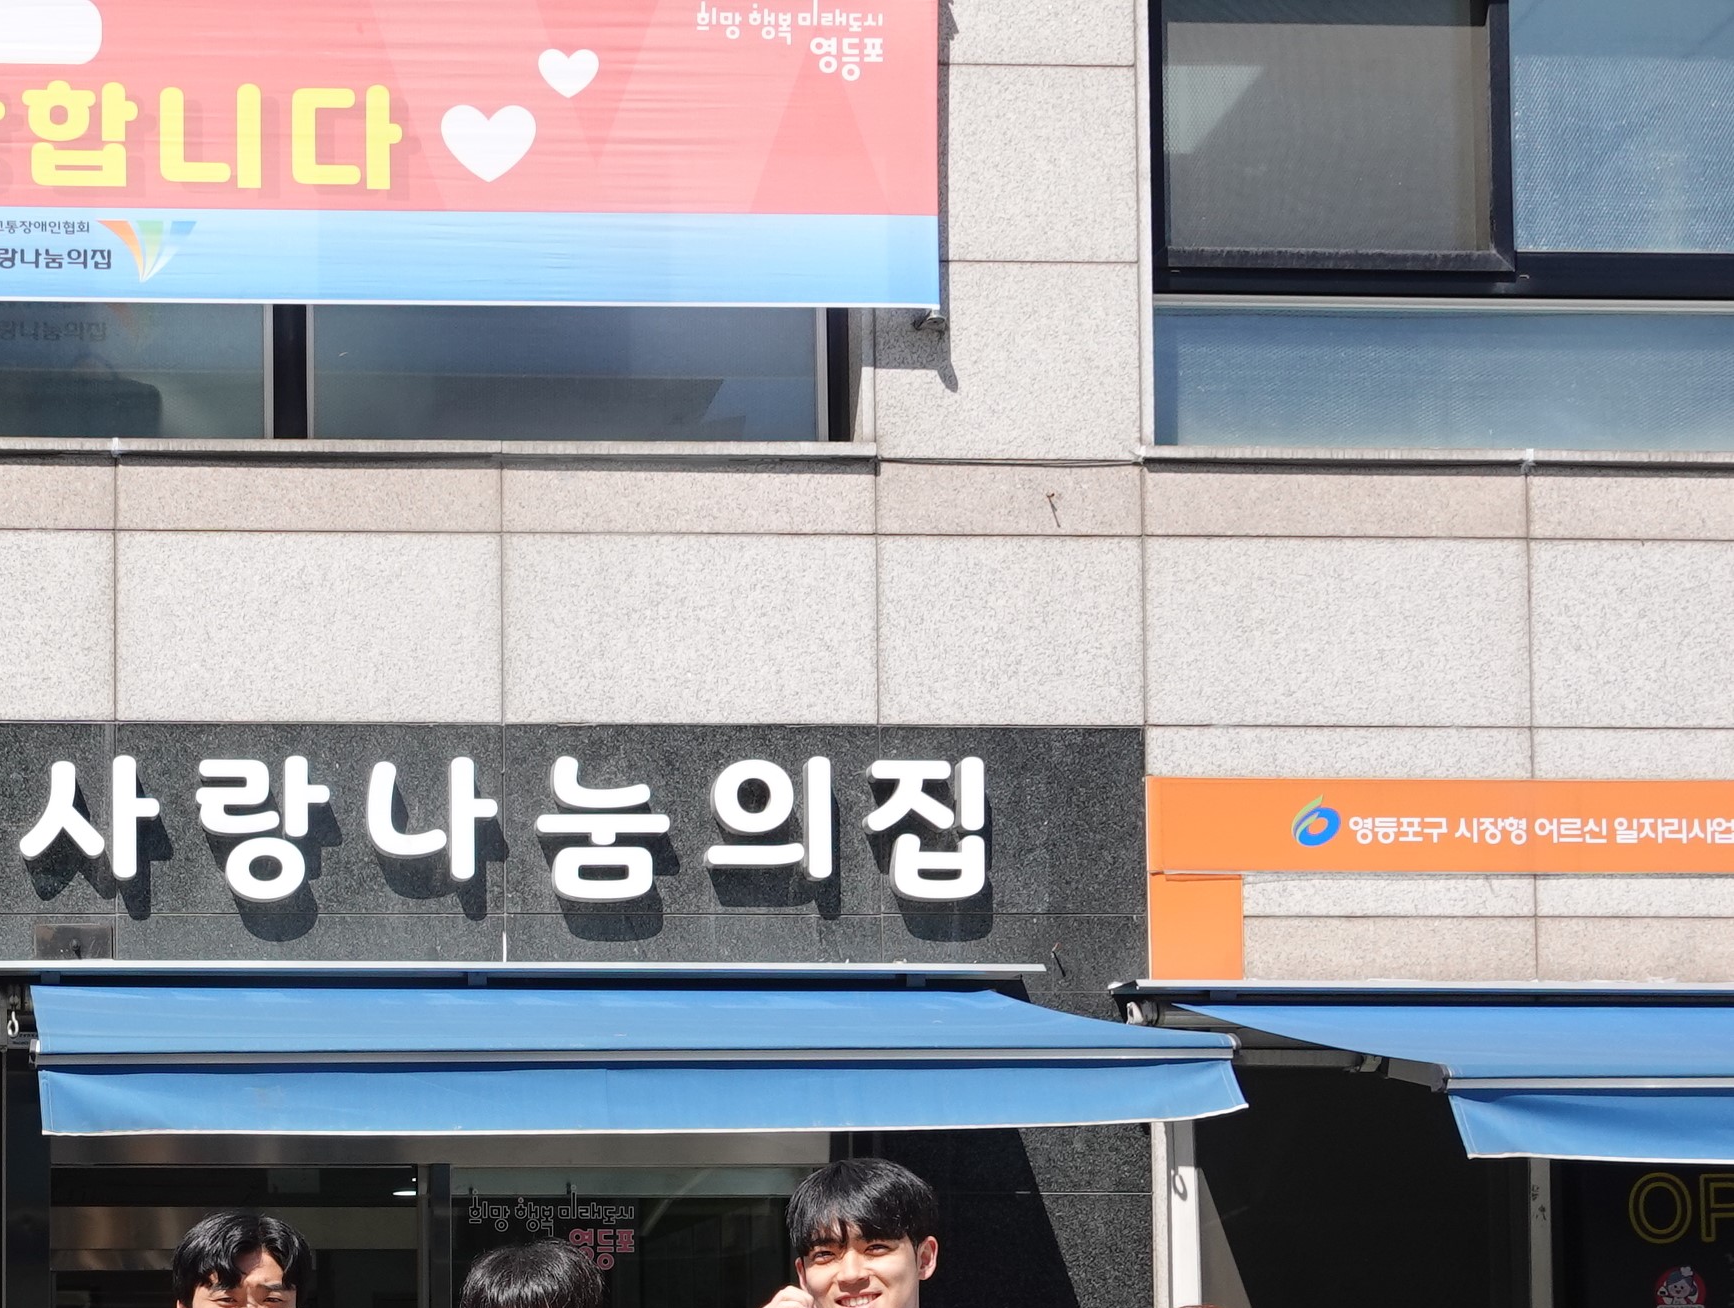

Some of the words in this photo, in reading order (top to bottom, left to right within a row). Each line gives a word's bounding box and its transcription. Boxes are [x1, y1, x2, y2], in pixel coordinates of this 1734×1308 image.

[696, 0, 742, 40] 희망
[748, 3, 792, 46] 행복
[797, 0, 883, 33] 미래도시
[809, 37, 884, 82] 영등포
[1348, 816, 1449, 845] 영등포구
[1454, 816, 1528, 846] 시장형
[1534, 817, 1608, 844] 어르신
[1613, 817, 1734, 844] 일자리사업
[468, 1189, 510, 1232] 희망
[514, 1196, 554, 1237] 행복
[557, 1184, 635, 1225] 미래도시
